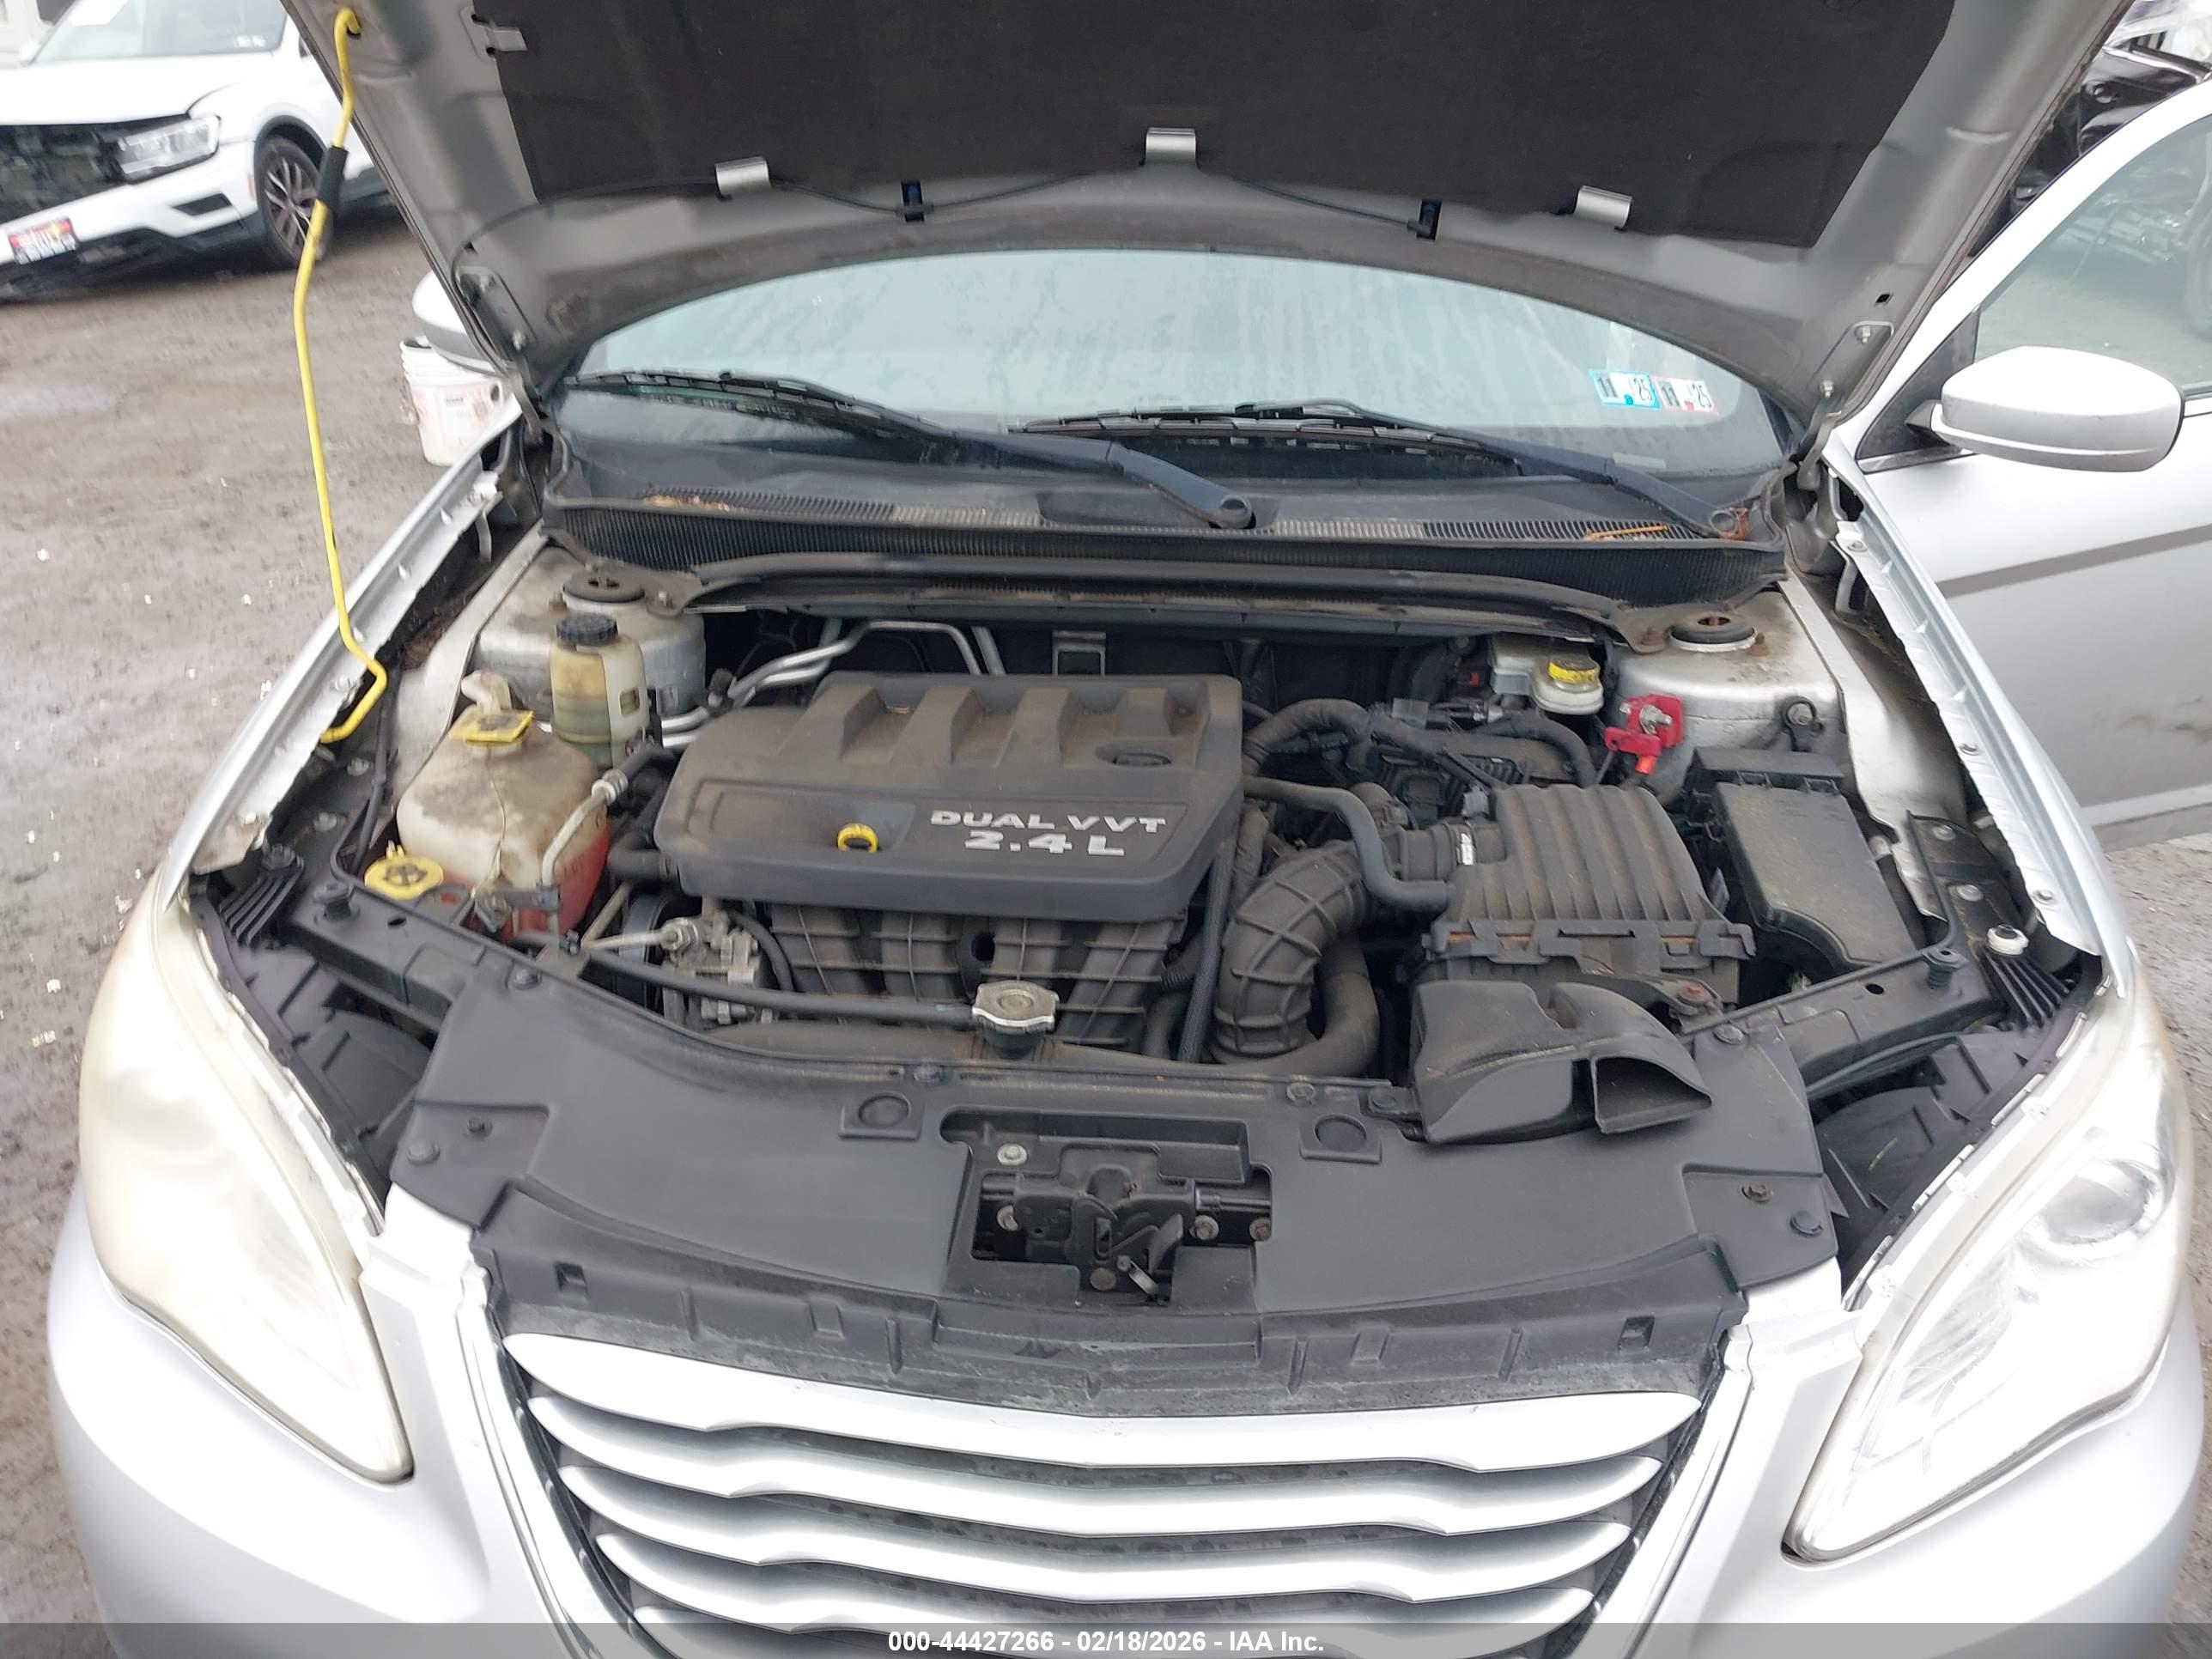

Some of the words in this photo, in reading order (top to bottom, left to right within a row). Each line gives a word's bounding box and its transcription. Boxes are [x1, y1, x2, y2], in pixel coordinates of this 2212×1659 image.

[930, 810, 1055, 830] DUAL
[1066, 815, 1167, 833] VVT
[964, 830, 1073, 854] 2.4
[1087, 834, 1126, 857] L
